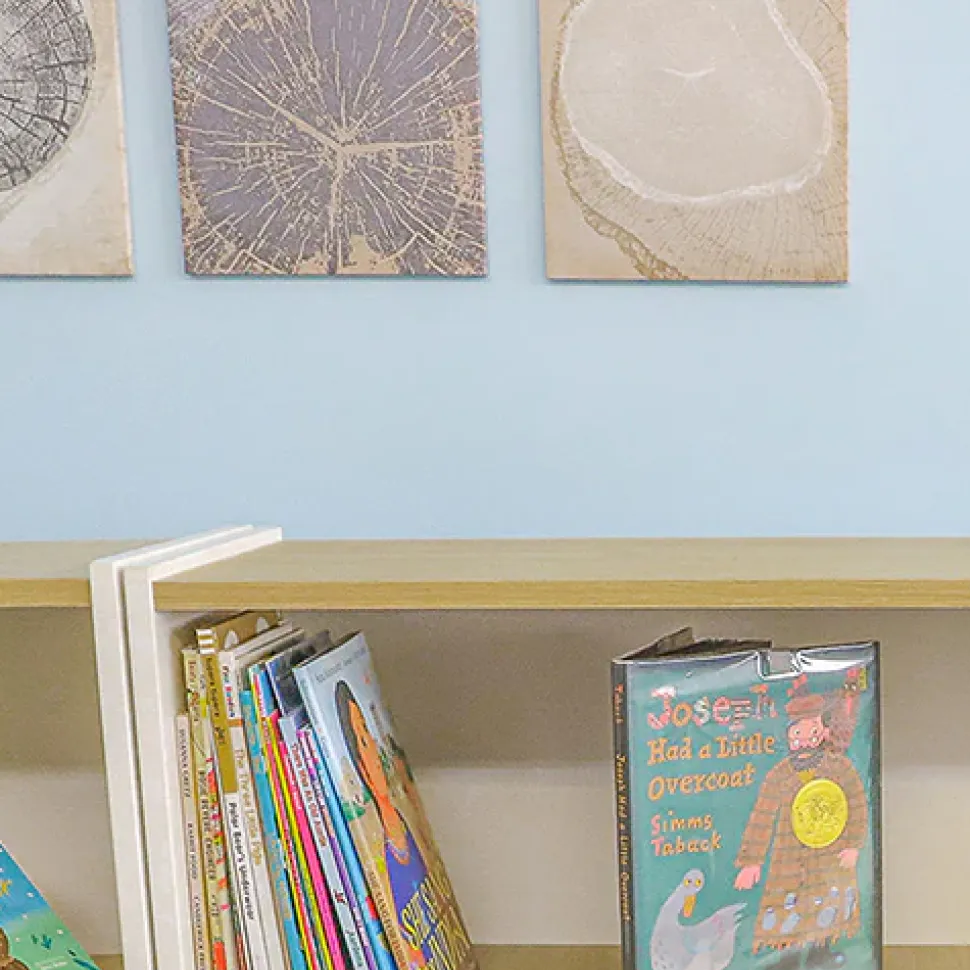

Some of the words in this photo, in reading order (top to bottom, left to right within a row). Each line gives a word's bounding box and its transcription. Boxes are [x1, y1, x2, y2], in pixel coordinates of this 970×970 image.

[647, 684, 778, 731] Joseph
[647, 736, 692, 766] Had
[698, 743, 711, 759] a
[715, 732, 775, 759] Little
[616, 754, 627, 792] Joseph
[647, 762, 756, 801] Overcoat
[617, 795, 627, 818] Had
[651, 810, 713, 835] Simms
[651, 831, 721, 857] Taback
